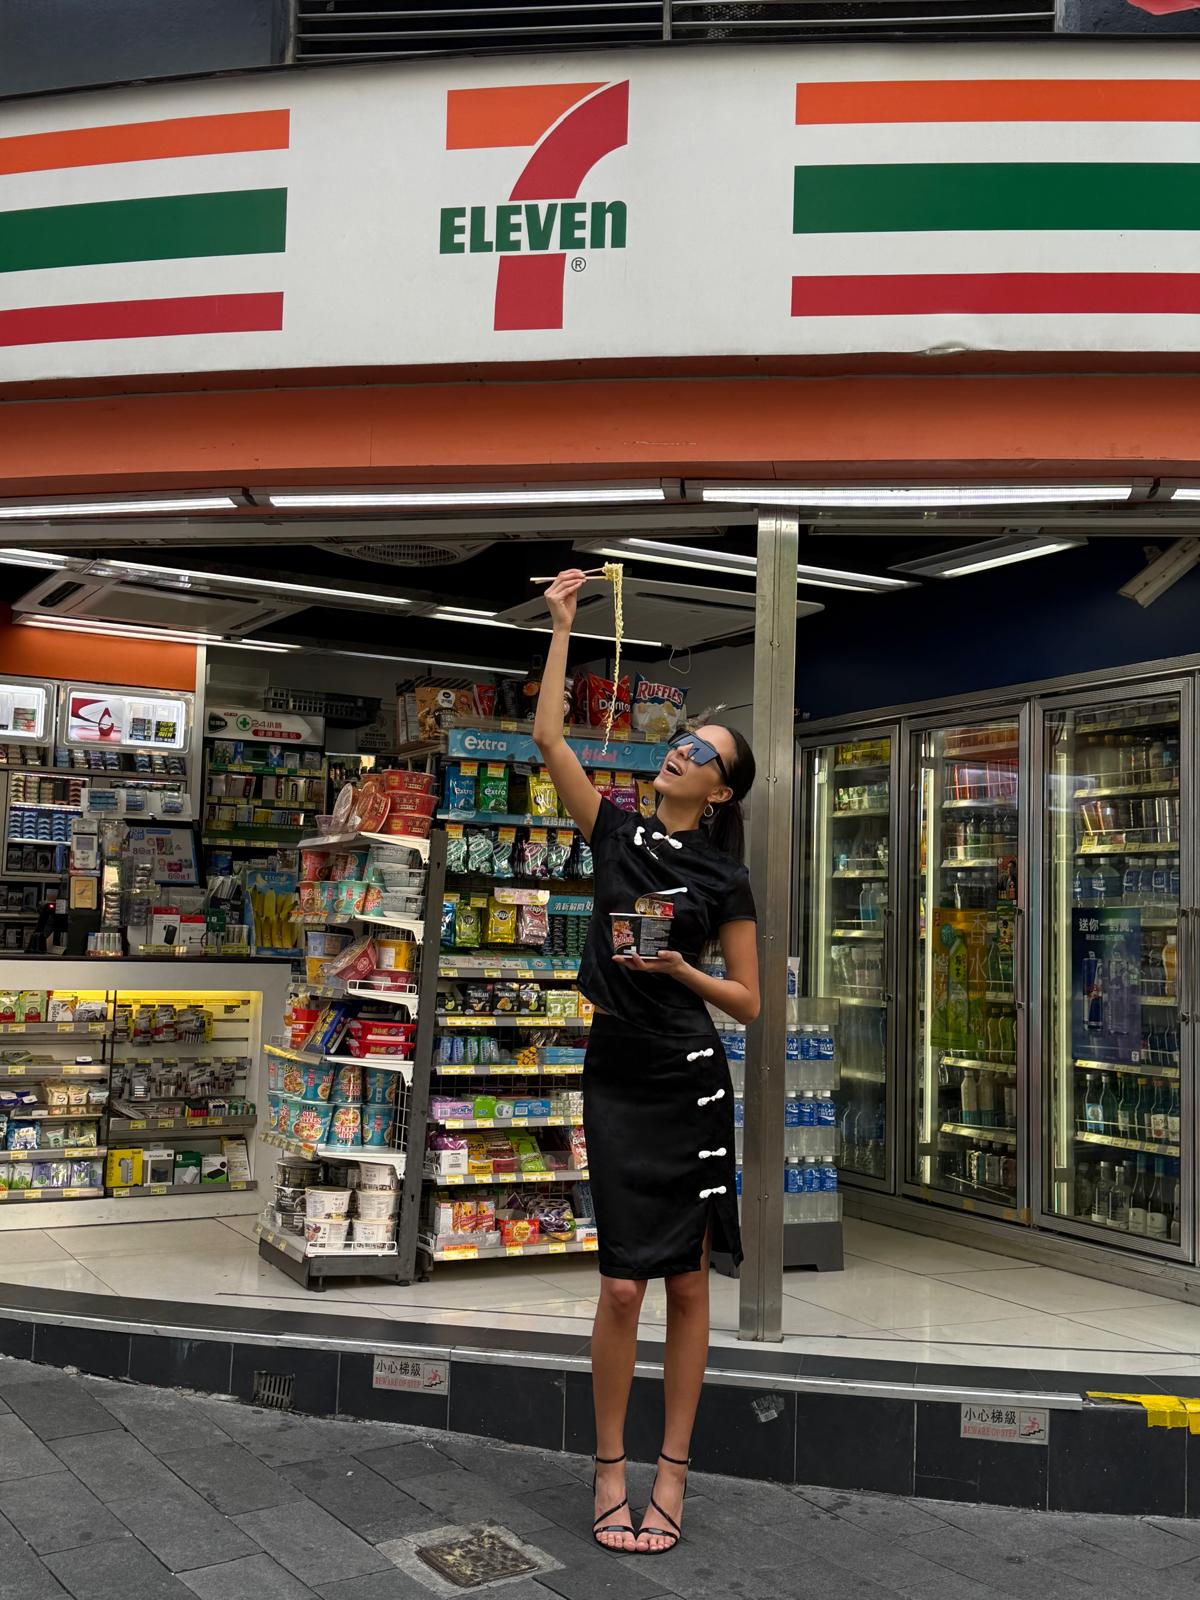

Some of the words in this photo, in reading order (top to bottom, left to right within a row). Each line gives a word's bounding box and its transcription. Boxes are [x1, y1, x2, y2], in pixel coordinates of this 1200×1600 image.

[446, 79, 630, 331] 7
[376, 1360, 421, 1376] 小心梯級
[964, 1407, 1017, 1424] 小心梯級
